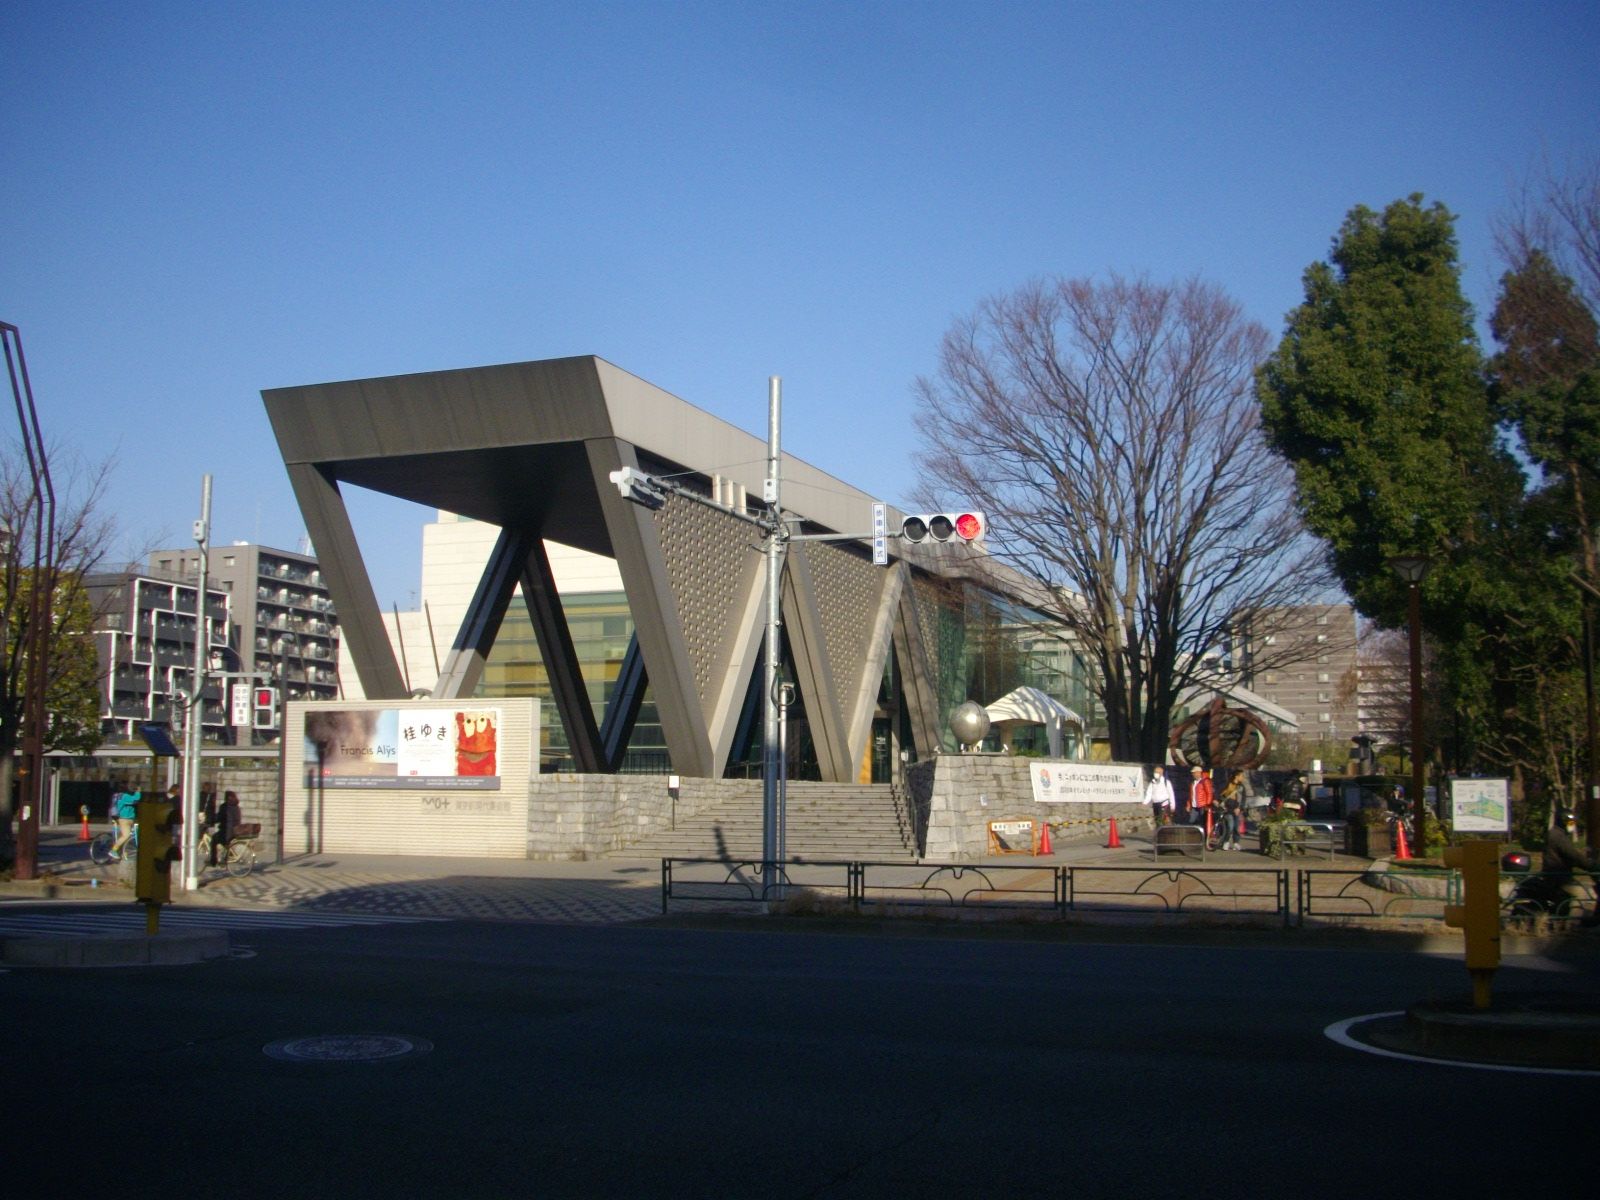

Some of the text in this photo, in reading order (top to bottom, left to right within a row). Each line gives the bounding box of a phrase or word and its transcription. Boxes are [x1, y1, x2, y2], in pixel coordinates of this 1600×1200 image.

[403, 723, 447, 741] 桂ゆき
[340, 745, 373, 755] Francis
